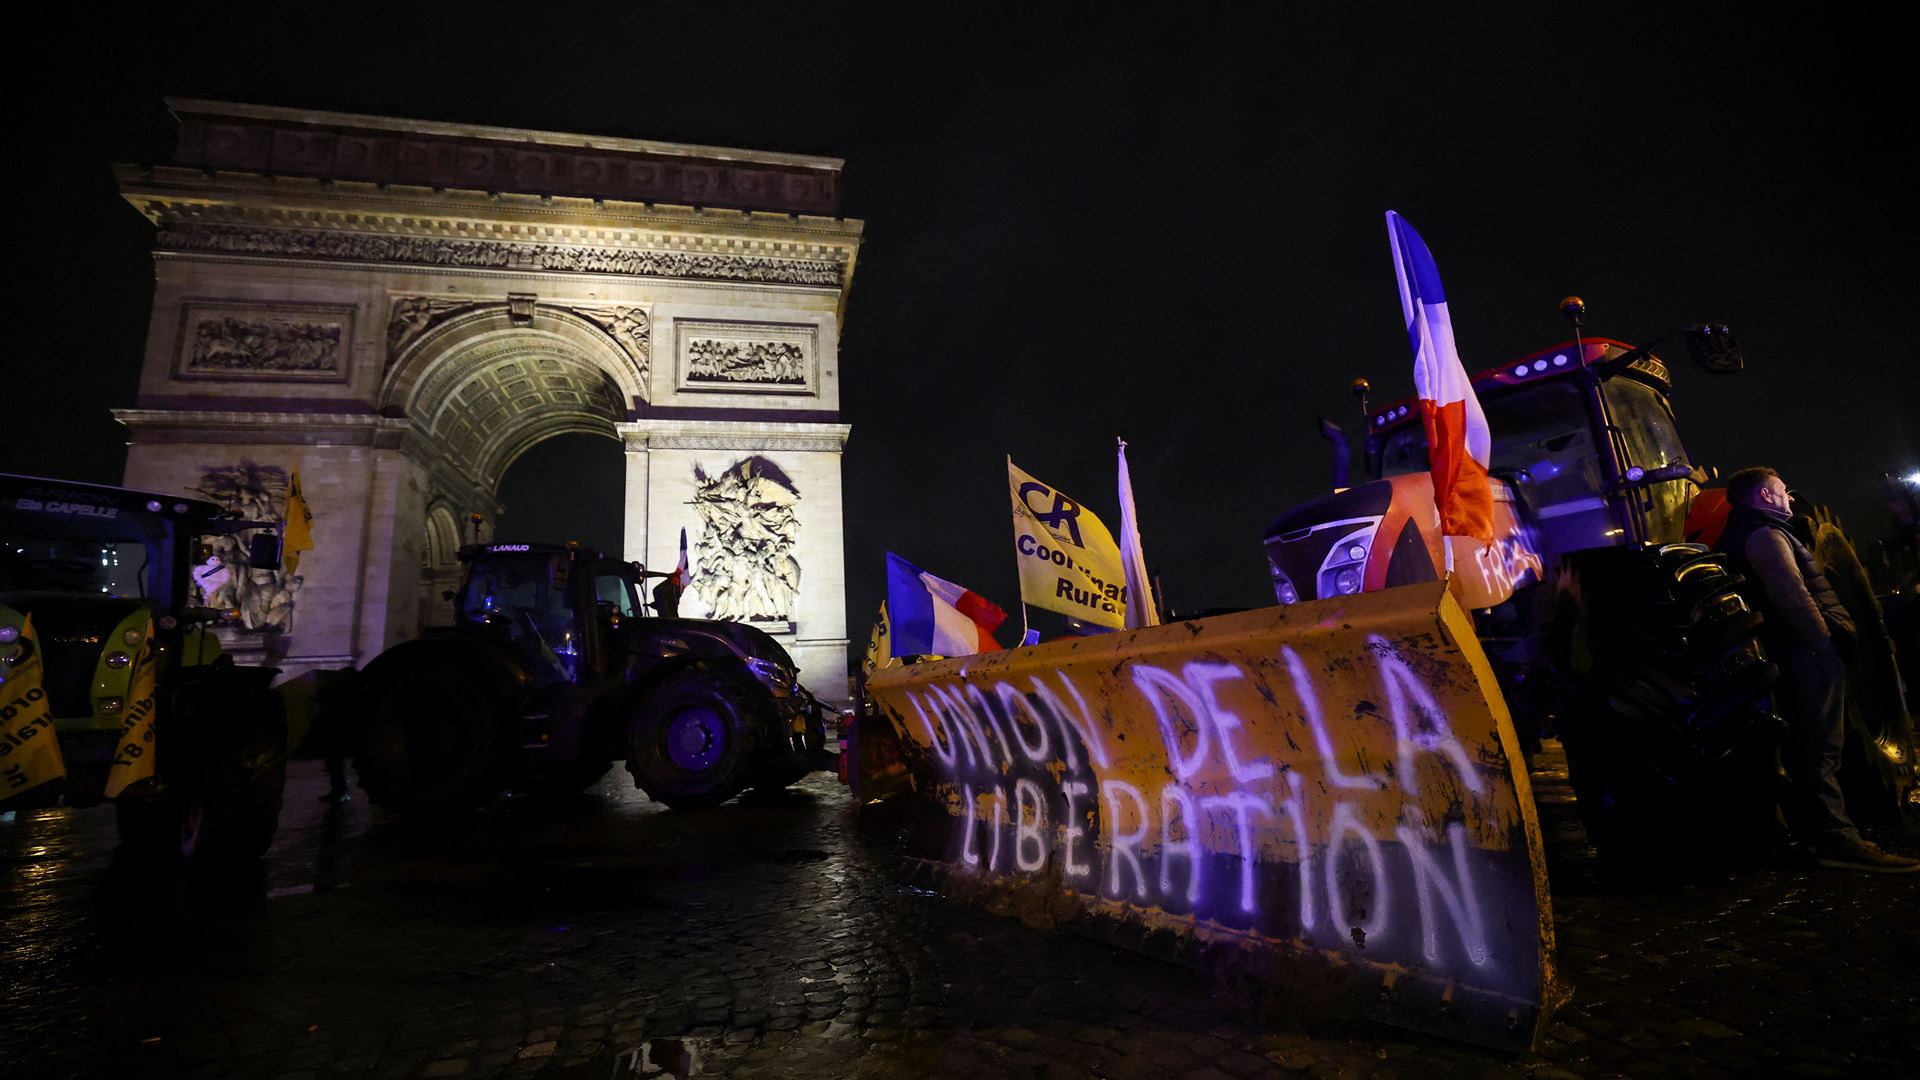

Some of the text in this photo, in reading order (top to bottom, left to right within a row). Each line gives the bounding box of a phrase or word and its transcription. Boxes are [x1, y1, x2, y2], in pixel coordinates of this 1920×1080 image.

[45, 500, 120, 519] CAPELLE
[1018, 481, 1086, 549] CR
[493, 544, 530, 552] LANAUD
[905, 634, 1484, 797] UNION DE LA
[961, 768, 1488, 968] LIBERATION
